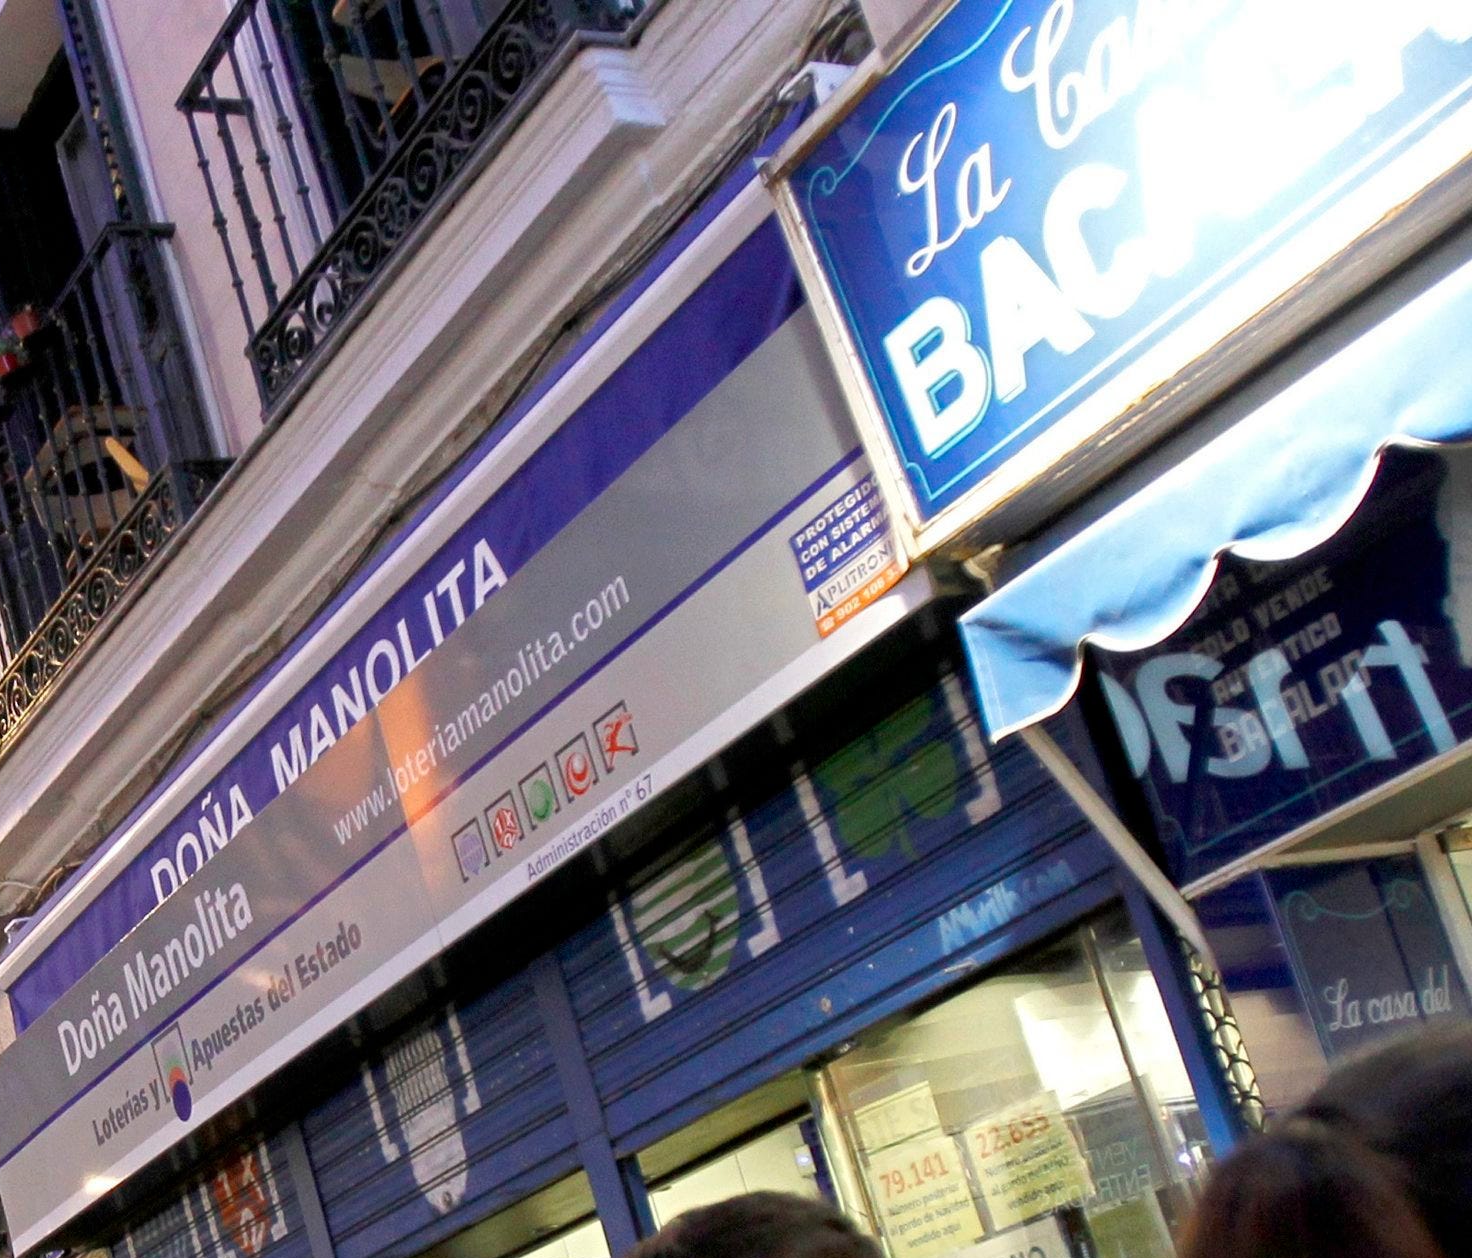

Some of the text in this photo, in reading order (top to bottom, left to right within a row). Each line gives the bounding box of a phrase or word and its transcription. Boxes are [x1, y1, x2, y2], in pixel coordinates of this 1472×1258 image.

[897, 102, 1012, 278] La
[800, 494, 885, 564] CON SISTEM
[804, 561, 828, 581] DE
[835, 596, 862, 621] 902
[150, 537, 509, 906] DOÑA MANOLITA
[333, 570, 631, 846] www.loteriamanolita.com
[528, 806, 617, 881] Administración
[635, 773, 654, 801] 67
[57, 882, 254, 1077] Doña Manolita
[149, 1078, 161, 1111] y
[191, 995, 265, 1072] Apuestas
[266, 964, 295, 1013] del
[294, 921, 363, 988] Estado
[1323, 963, 1452, 1033] La casa del
[878, 1152, 950, 1200] 79.141
